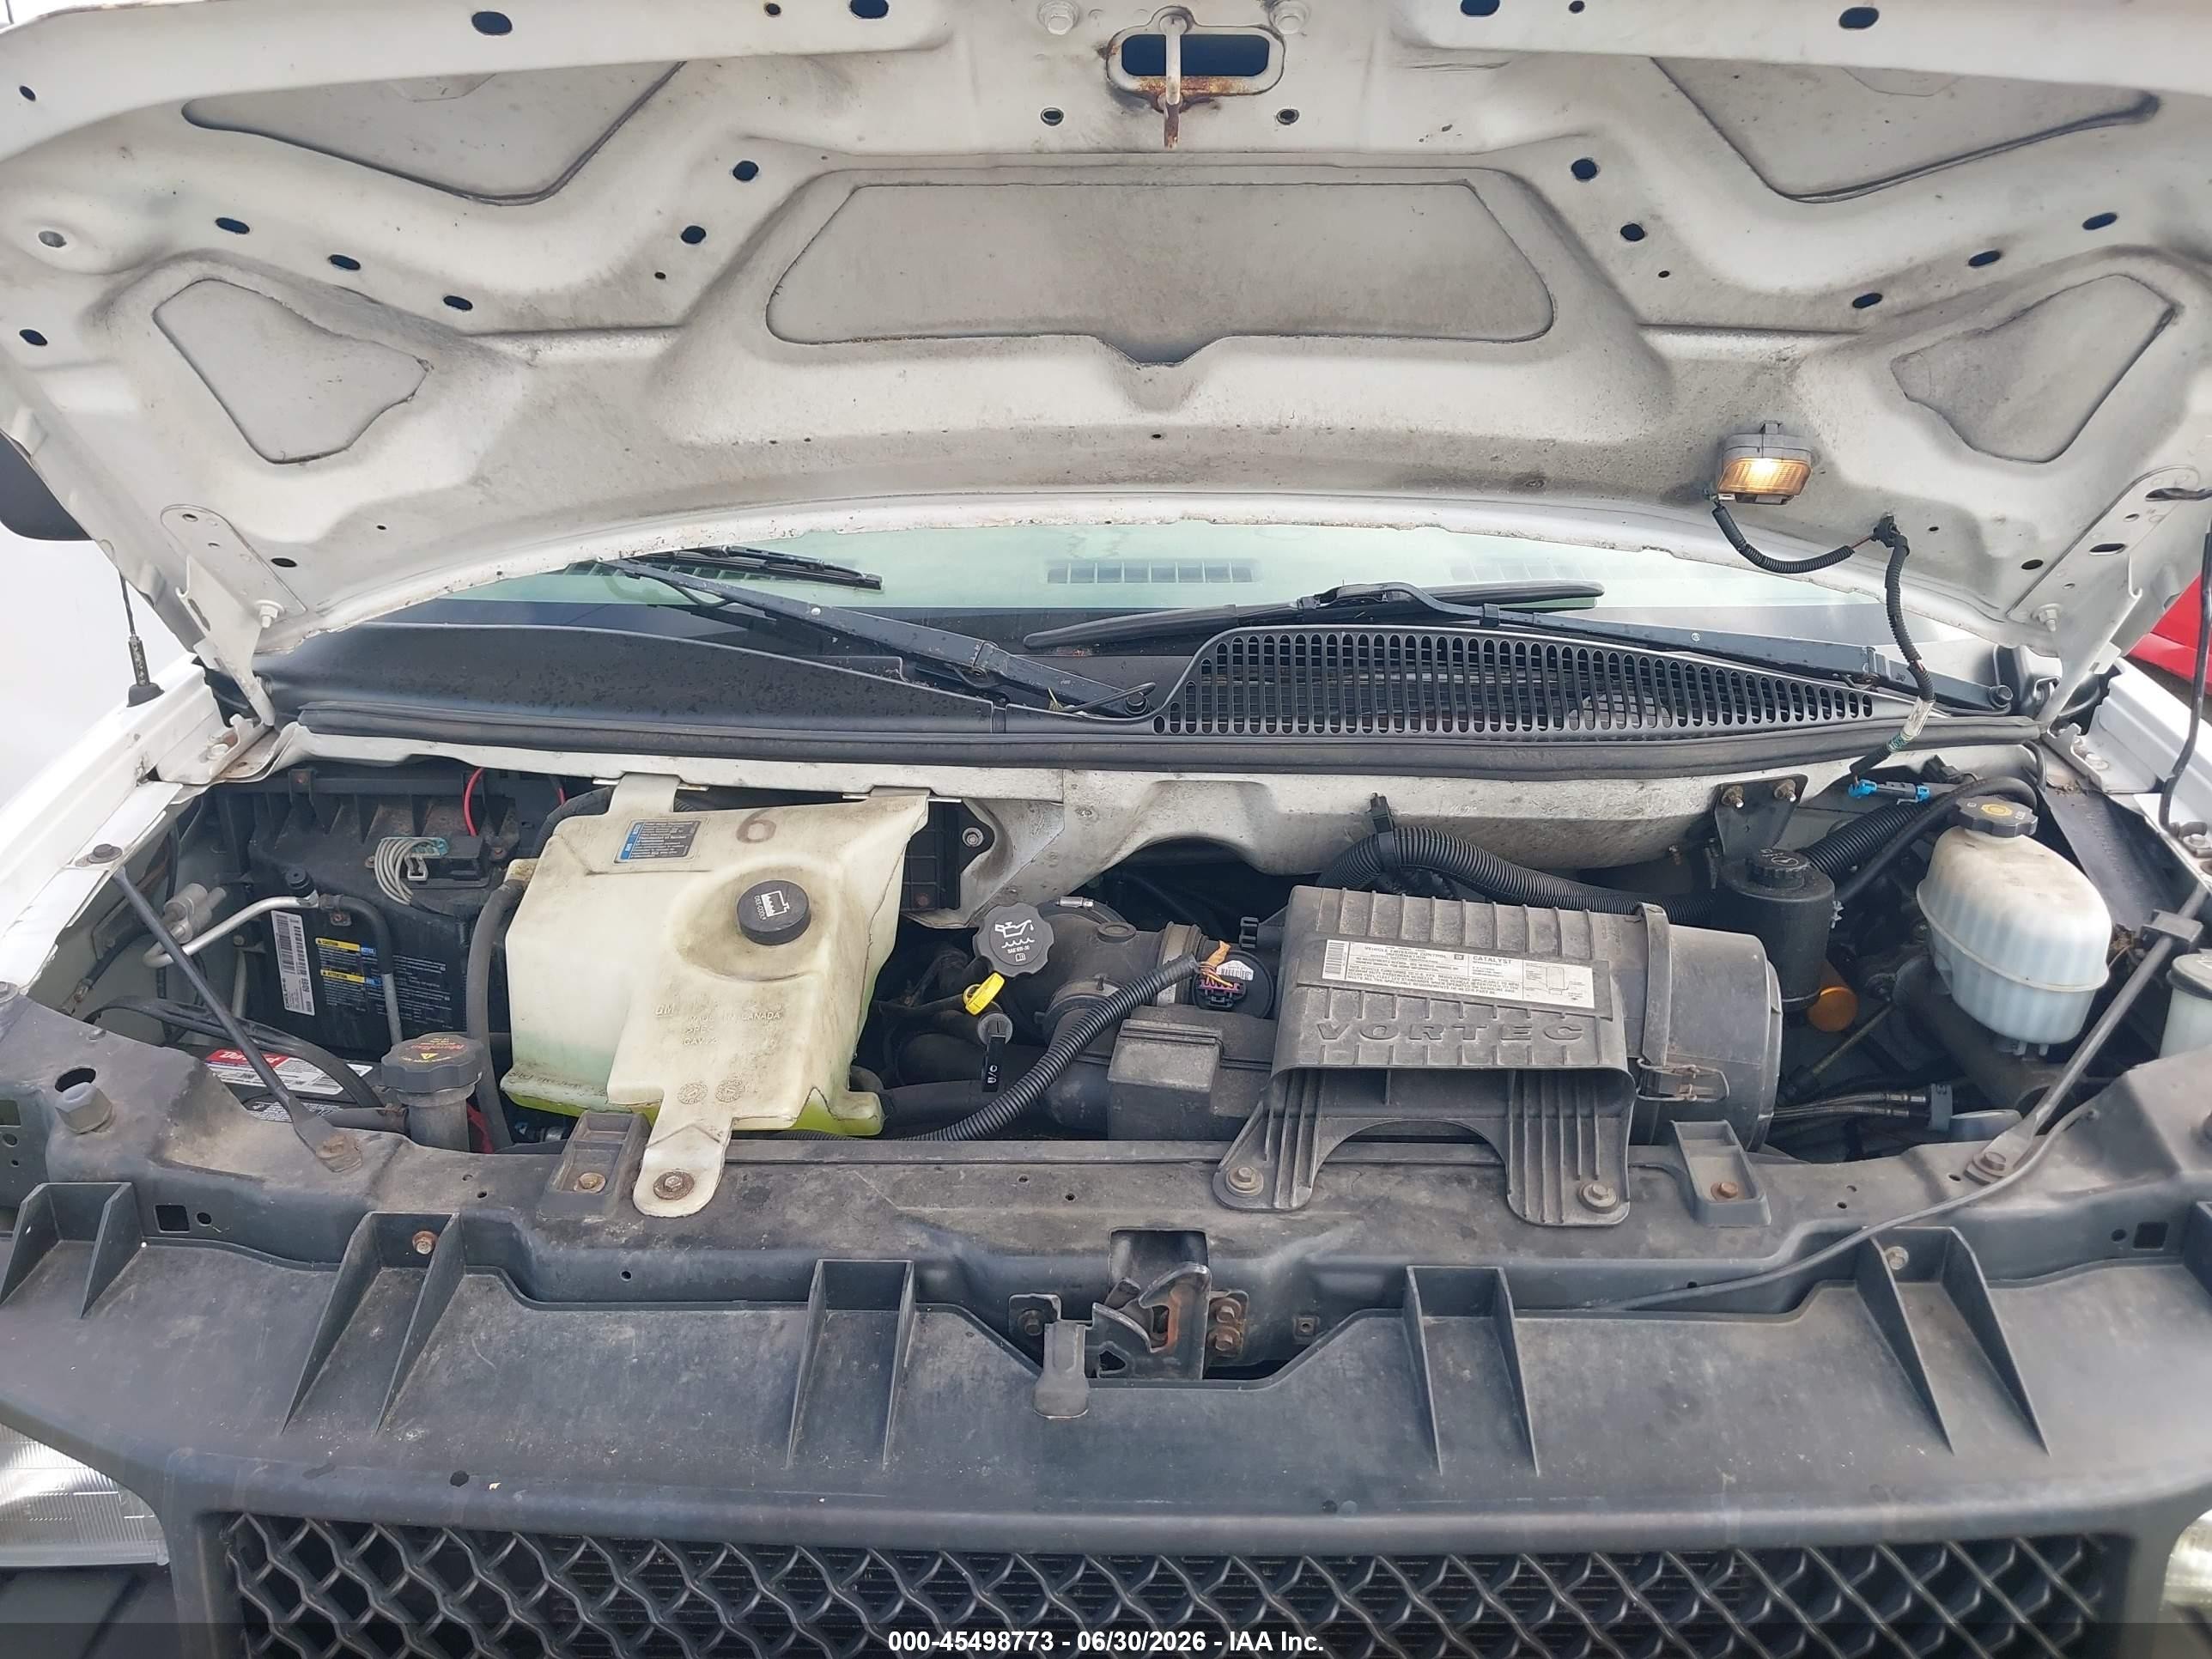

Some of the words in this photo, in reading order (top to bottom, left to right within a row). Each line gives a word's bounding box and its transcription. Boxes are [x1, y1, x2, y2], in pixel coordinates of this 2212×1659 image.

[736, 808, 778, 845] 6
[741, 1012, 781, 1021] CANADA
[1316, 1022, 1583, 1042] VORTEC
